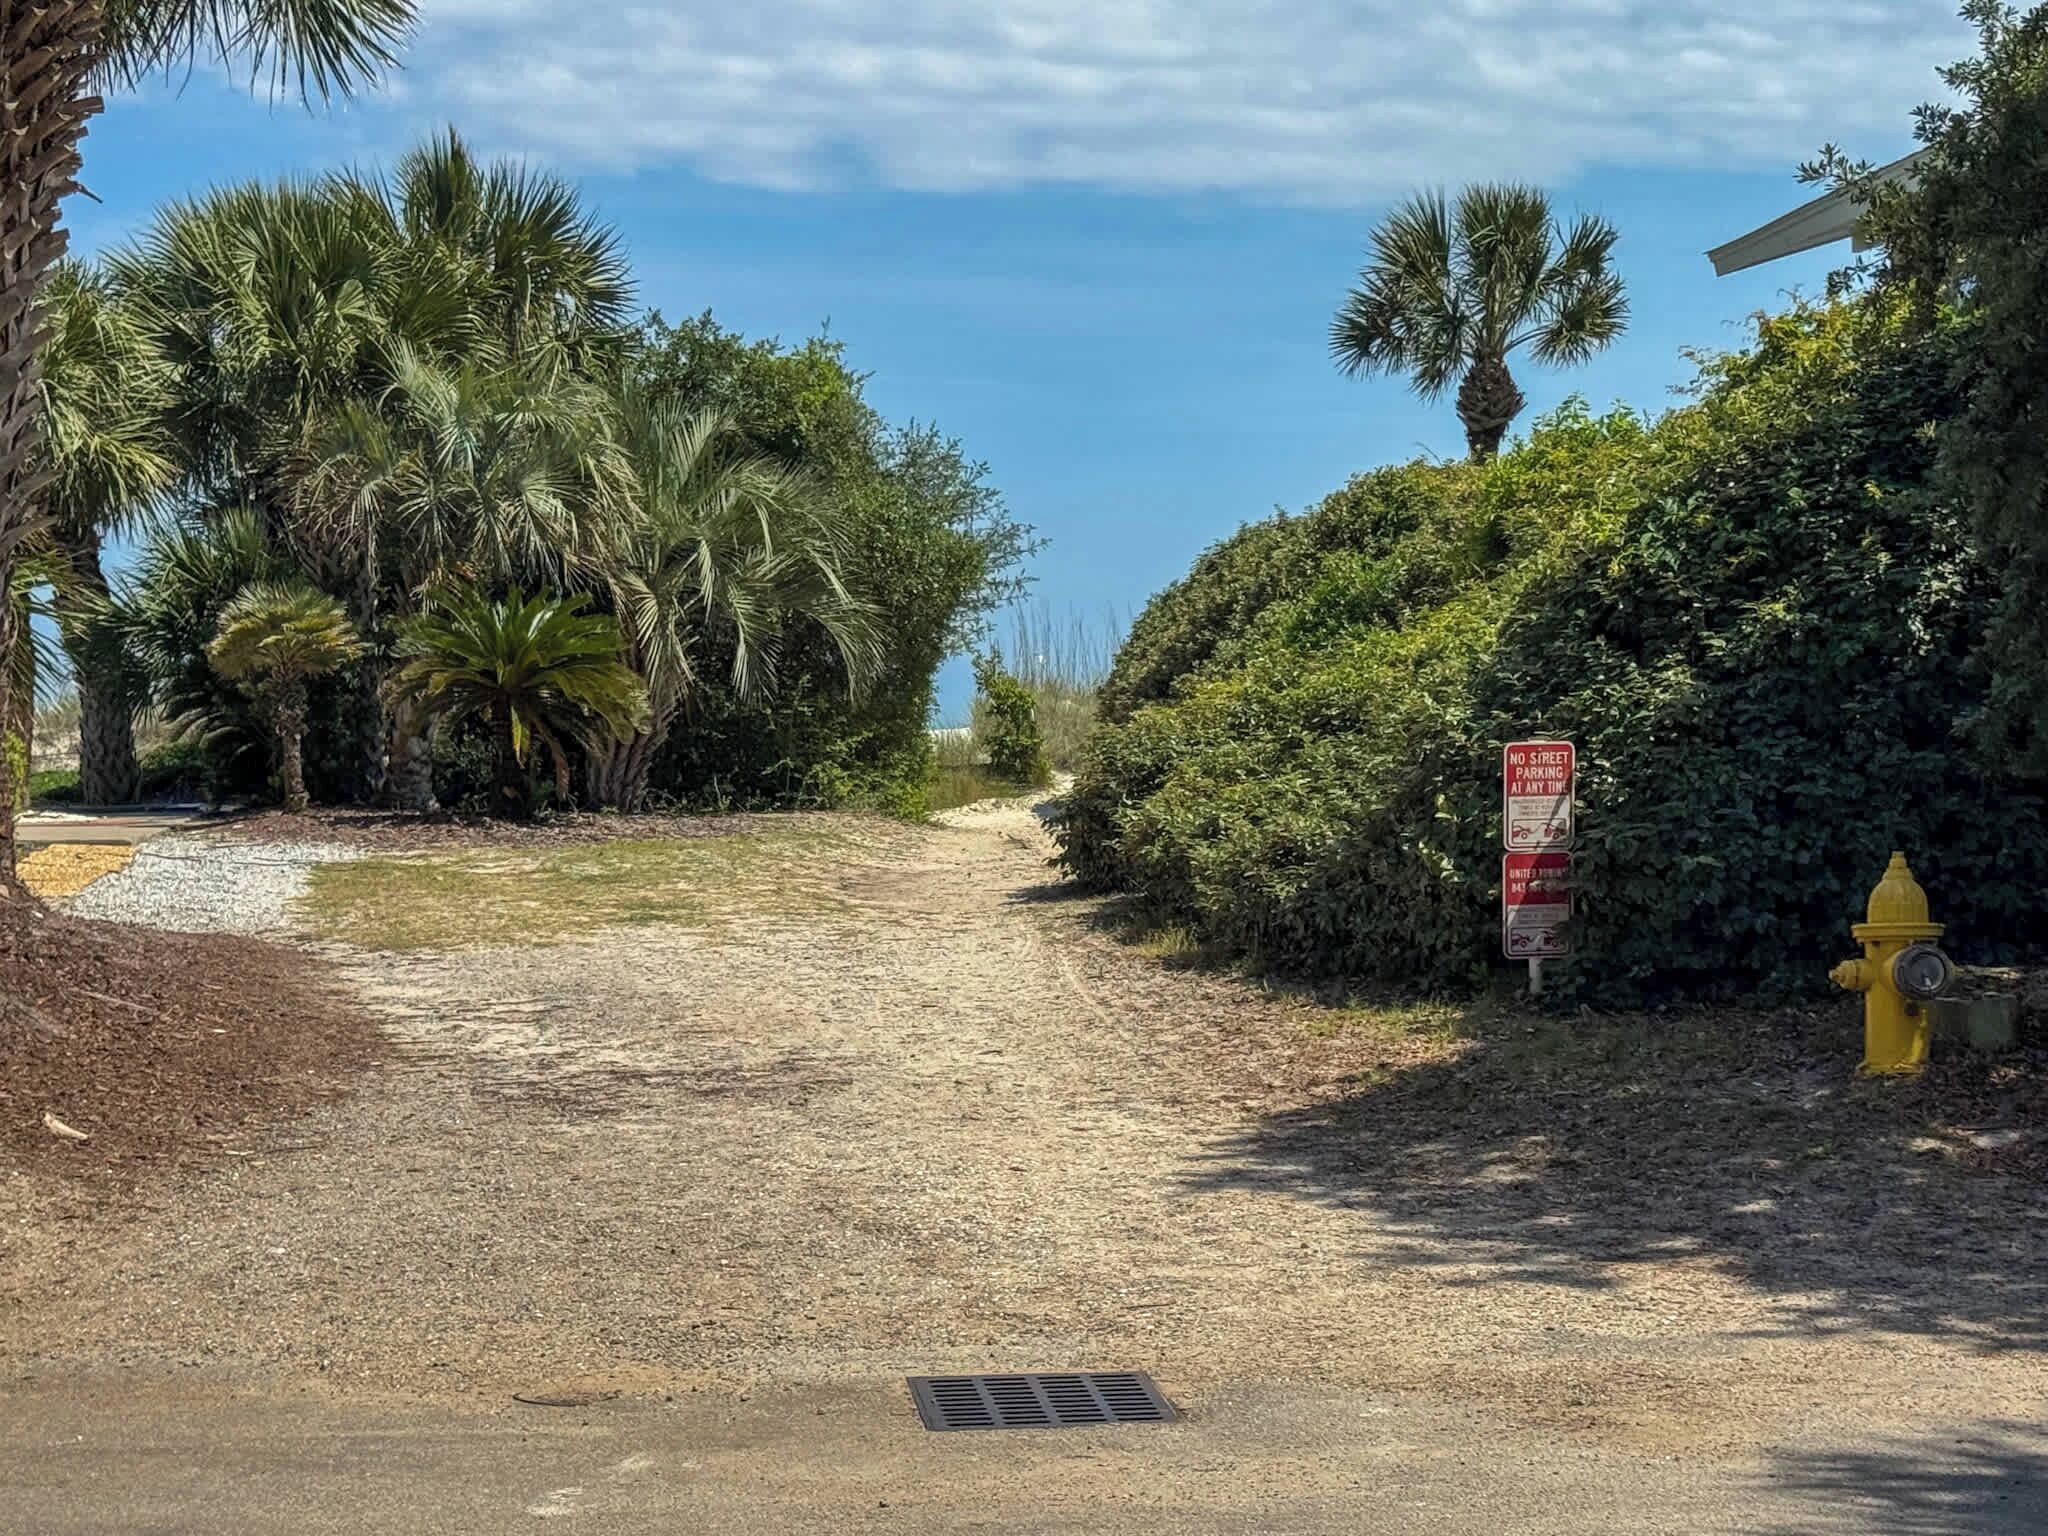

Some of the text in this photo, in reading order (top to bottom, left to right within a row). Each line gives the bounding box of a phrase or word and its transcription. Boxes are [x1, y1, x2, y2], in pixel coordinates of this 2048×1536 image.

[1510, 751, 1569, 765] NO STREET
[1515, 766, 1564, 779] PARKING
[1511, 781, 1522, 794] AT
[1526, 781, 1544, 793] ANY
